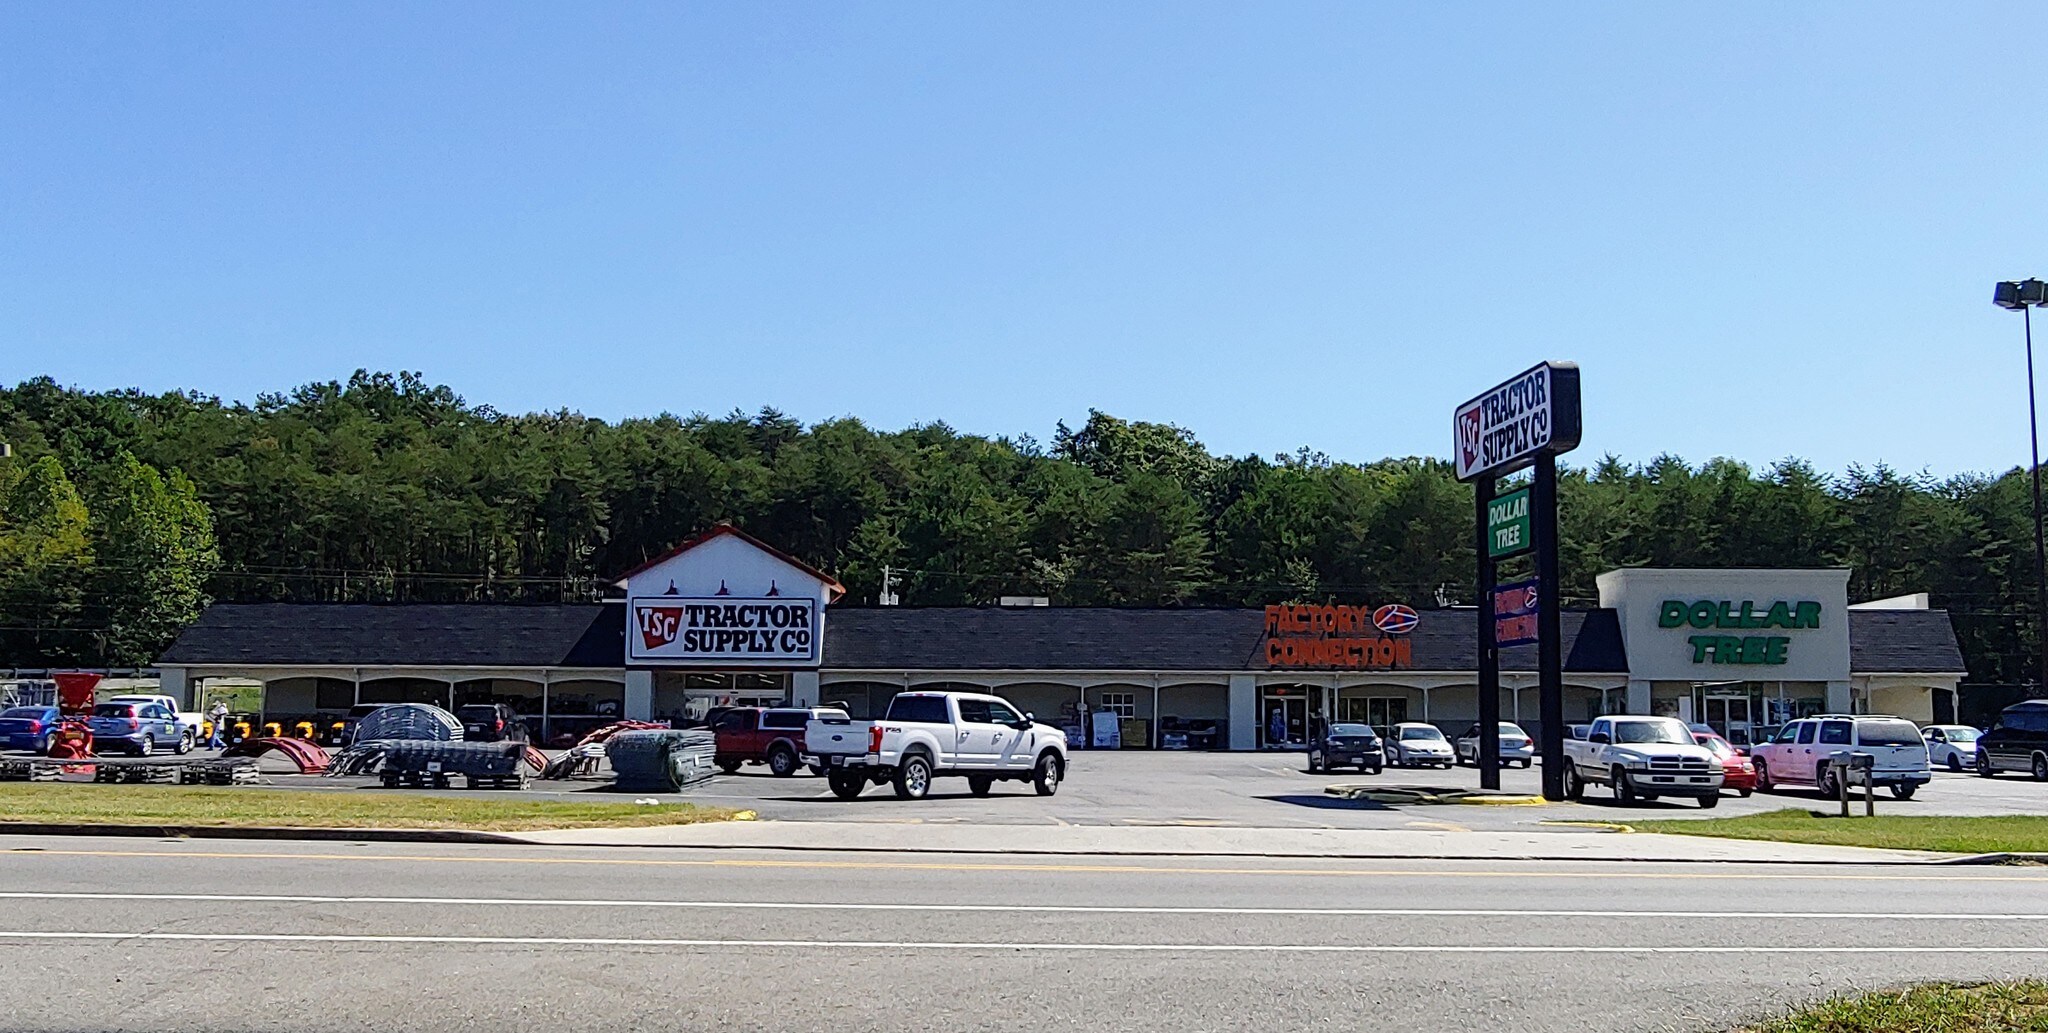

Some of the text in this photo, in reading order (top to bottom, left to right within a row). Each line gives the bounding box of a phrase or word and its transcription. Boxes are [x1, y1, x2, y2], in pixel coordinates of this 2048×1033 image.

[1482, 371, 1546, 431] TRACTOR
[1461, 415, 1478, 458] TSC
[1482, 416, 1530, 467] SUPPLY
[1489, 497, 1527, 526] DOLLAR
[1496, 524, 1520, 549] TREE
[641, 608, 675, 641] TSC
[685, 605, 808, 628] TRACTOR
[1265, 604, 1368, 632] FACTORY
[1658, 600, 1822, 629] DOLLAR
[684, 630, 778, 653] SUPPLY
[1265, 638, 1411, 666] CONNECTION
[1688, 635, 1791, 664] TREE
